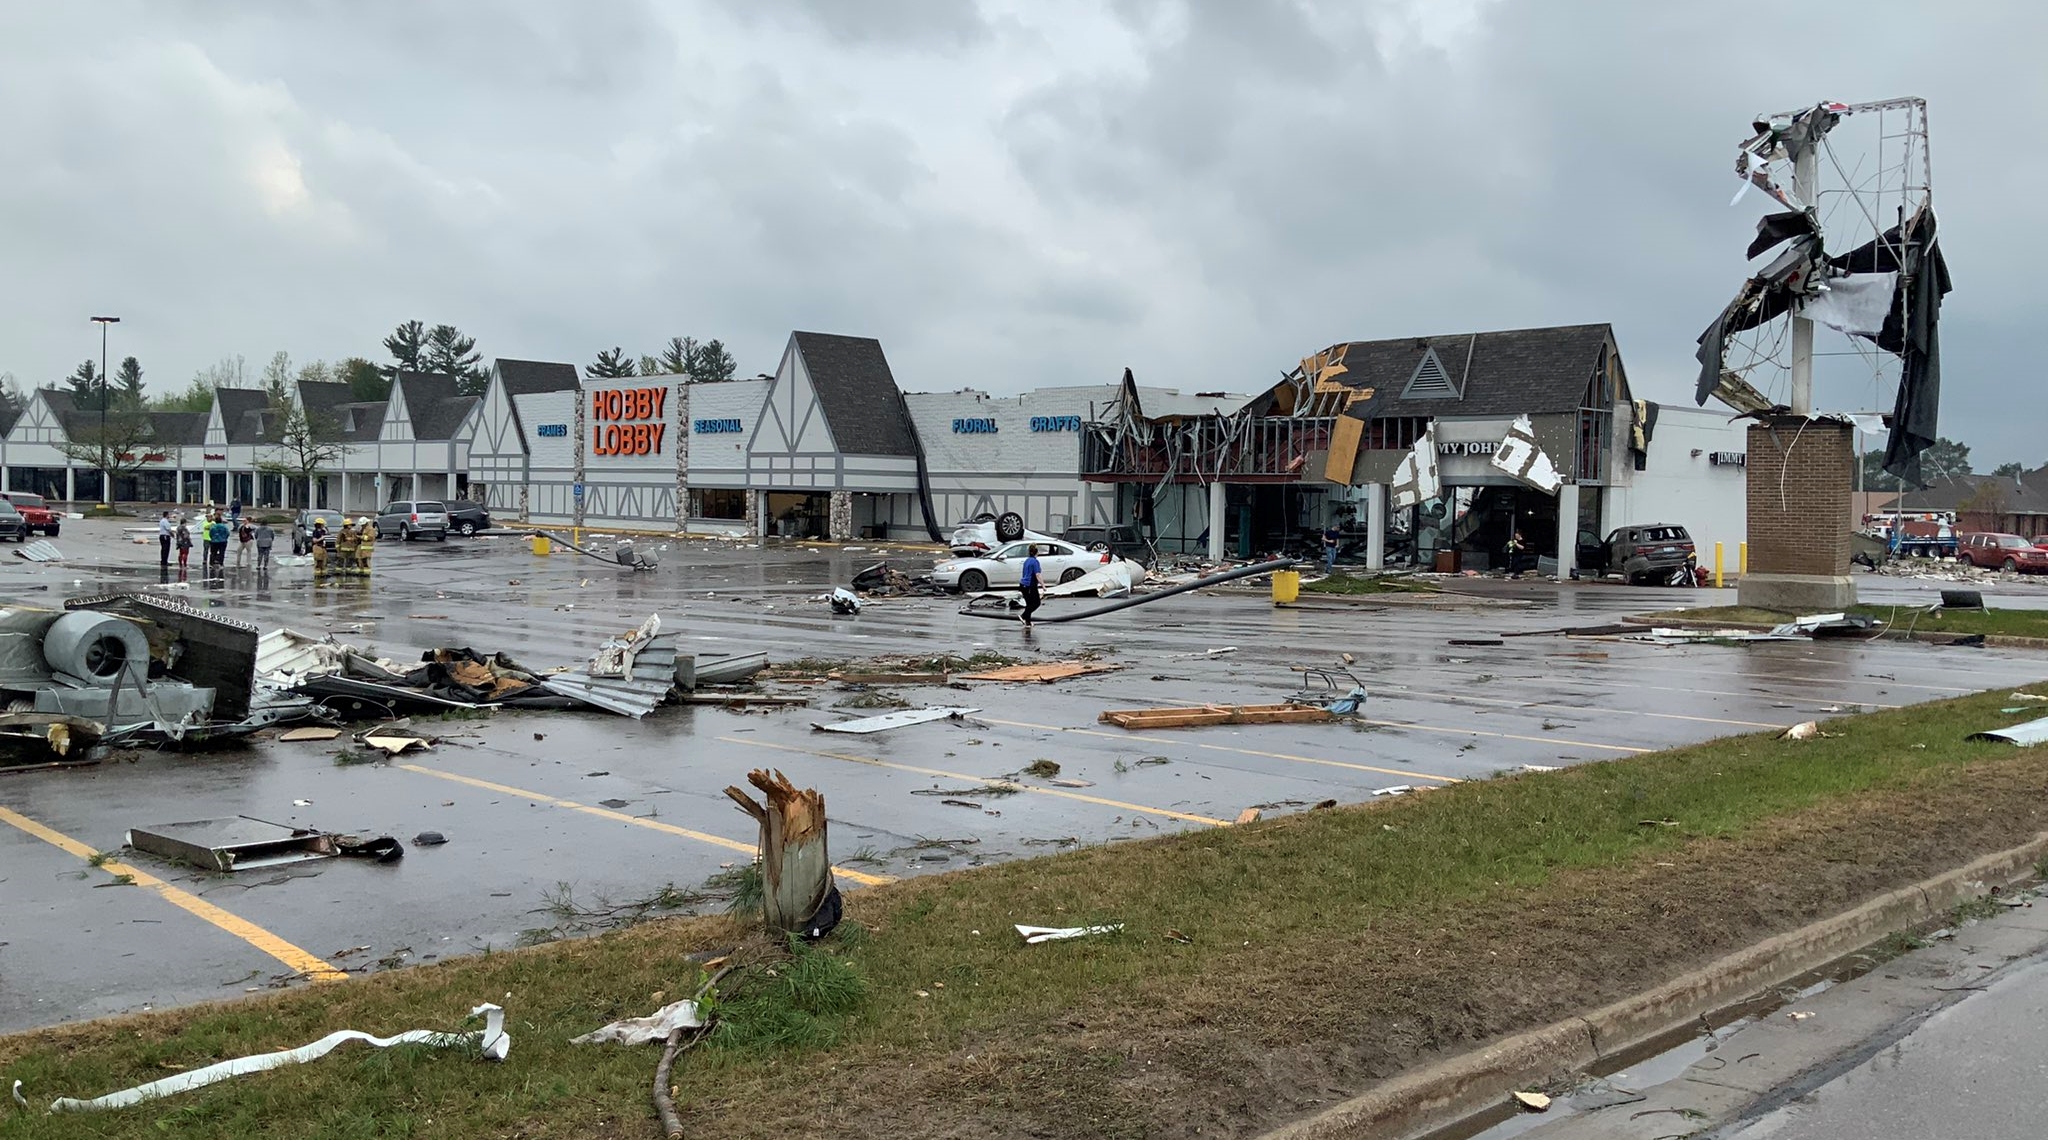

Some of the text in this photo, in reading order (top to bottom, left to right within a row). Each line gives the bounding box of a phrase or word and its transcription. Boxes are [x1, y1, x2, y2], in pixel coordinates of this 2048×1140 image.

[592, 387, 668, 421] HOBBY
[537, 424, 567, 436] FRAMES
[694, 419, 743, 433] SEASONAL
[952, 417, 998, 433] FLORAL
[1030, 415, 1081, 432] CRAFTS
[593, 423, 666, 455] LOBBY
